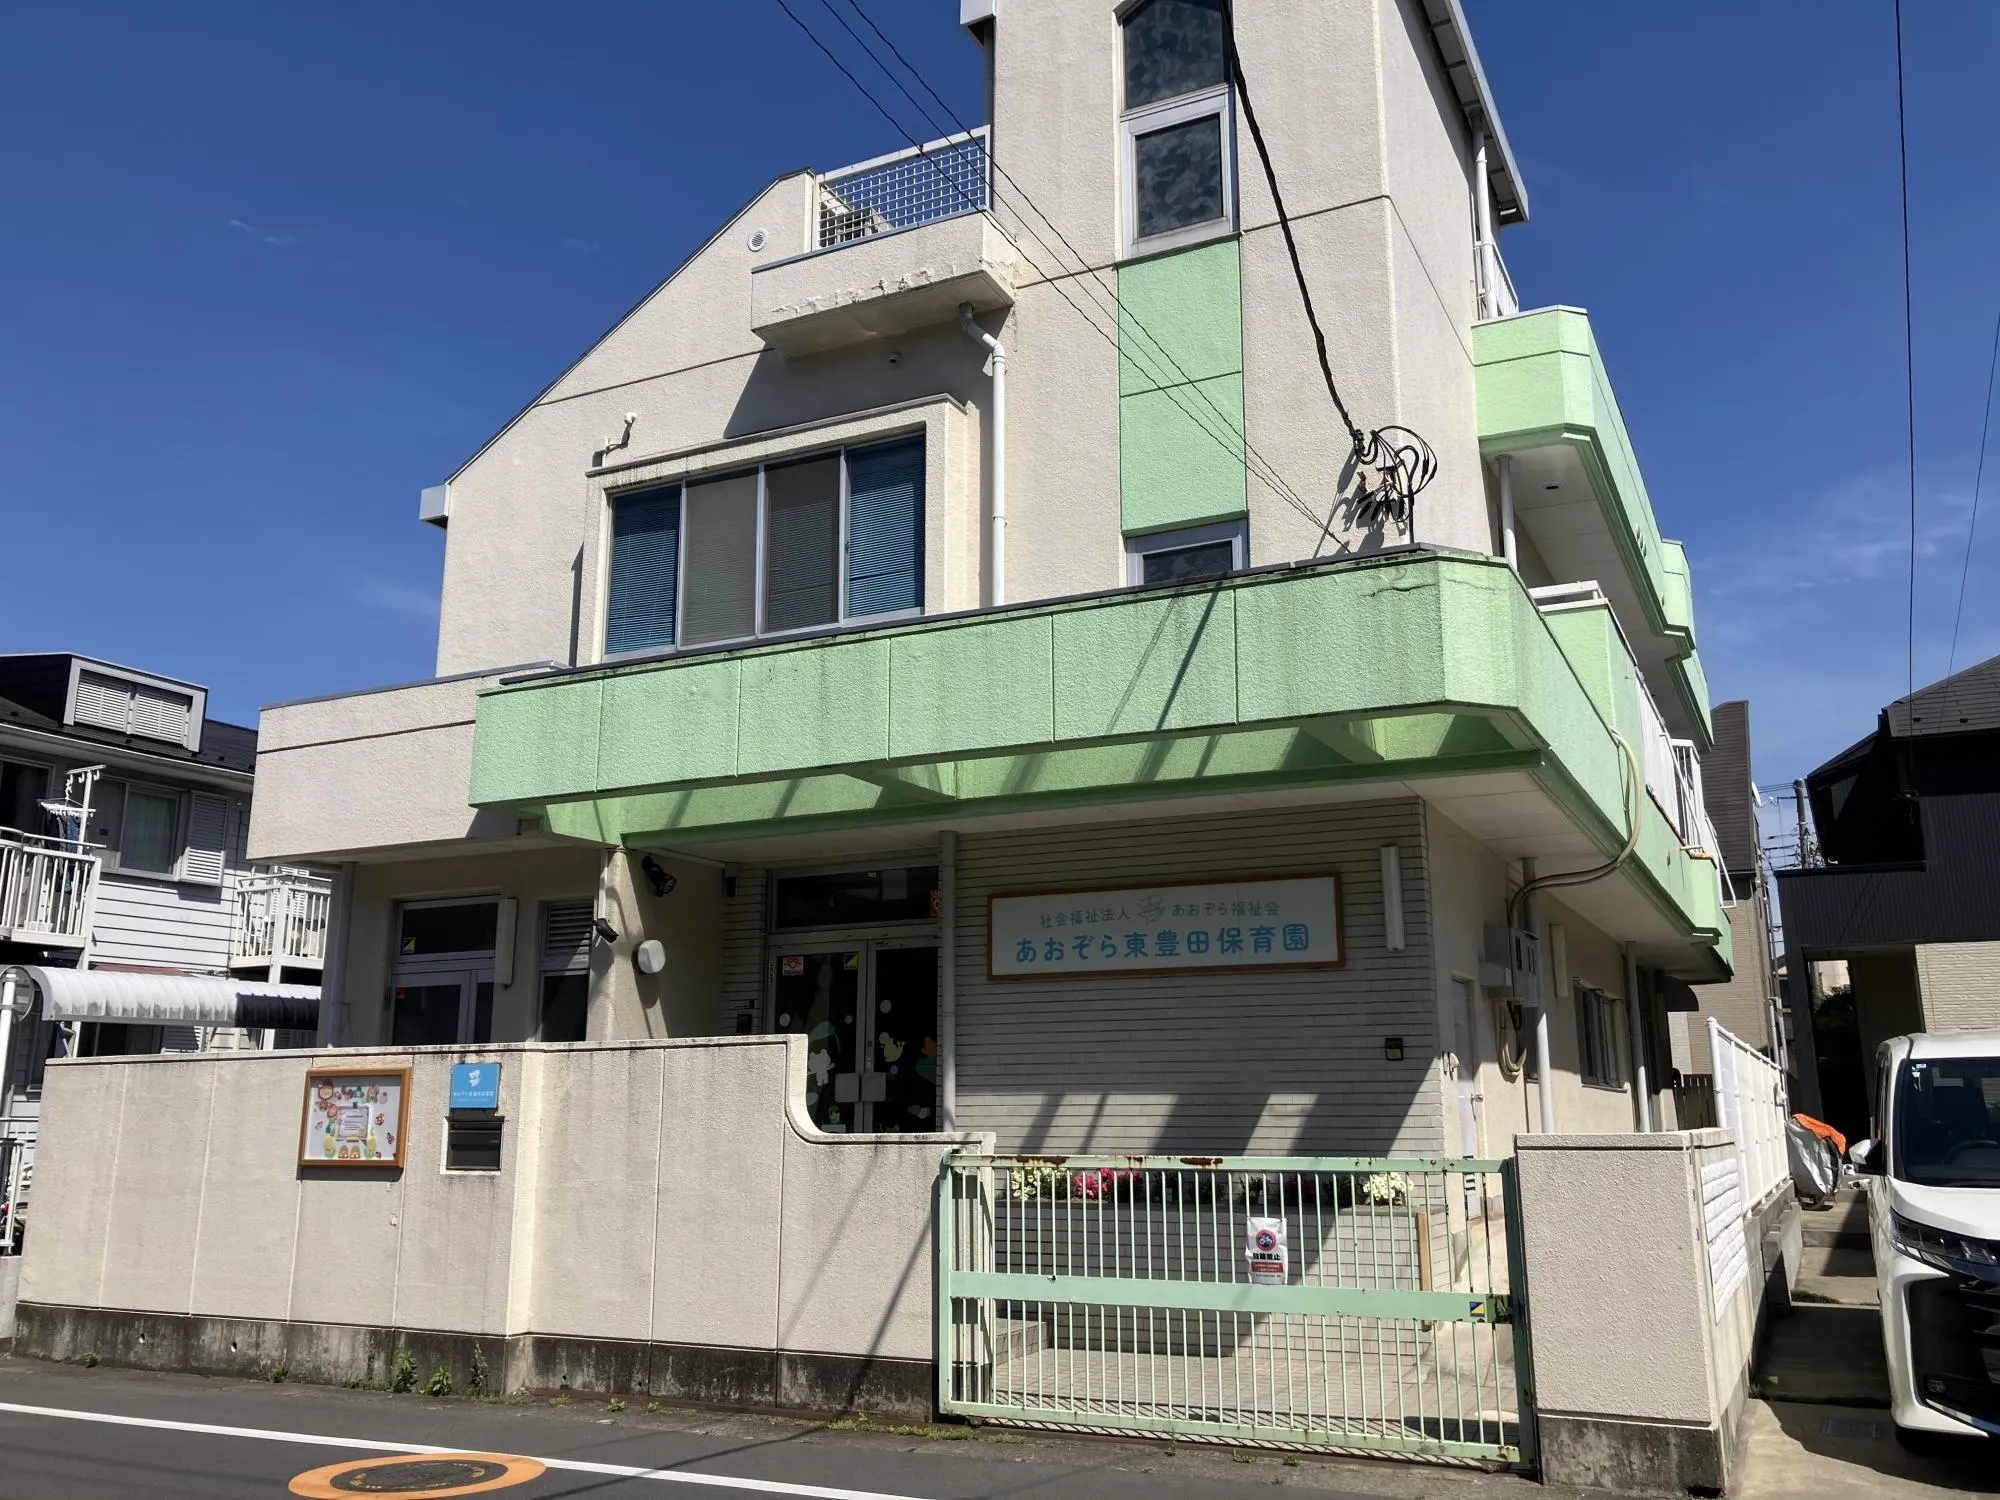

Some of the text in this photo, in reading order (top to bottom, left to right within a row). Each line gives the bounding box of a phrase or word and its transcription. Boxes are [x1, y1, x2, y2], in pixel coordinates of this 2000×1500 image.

[1039, 900, 1279, 928] 社会福祉法人 あおぞら福祉会
[1015, 923, 1310, 963] あおぞら東豊田保育園
